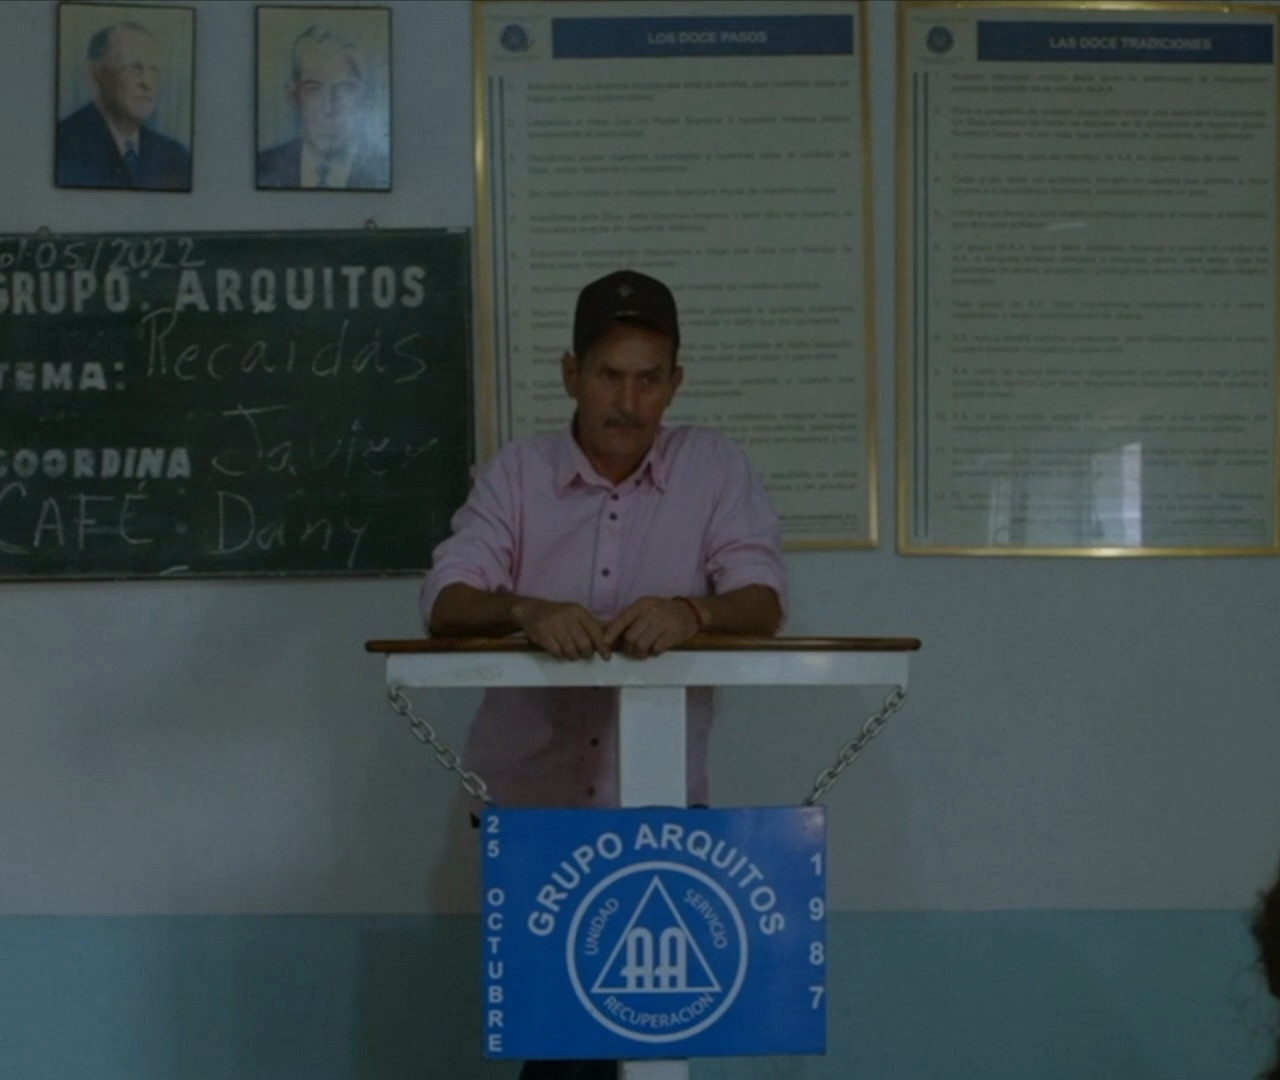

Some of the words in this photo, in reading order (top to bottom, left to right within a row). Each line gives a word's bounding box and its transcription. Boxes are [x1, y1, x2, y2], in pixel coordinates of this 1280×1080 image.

[647, 31, 676, 44] LOS
[679, 31, 717, 44] DOCE
[720, 30, 768, 44] PASOS
[1049, 36, 1077, 50] LAS
[1079, 36, 1118, 50] DOCE
[1120, 36, 1213, 51] TRADICIONES
[175, 265, 427, 315] ARQUITOS
[527, 831, 624, 938] GRUPO
[633, 822, 786, 936] ARQUITOS
[584, 896, 620, 957] UNIDAD
[682, 887, 729, 950] SERVICIO
[807, 851, 826, 1011] 1987
[486, 887, 505, 1053] OCTUBRE
[619, 926, 688, 989] AA
[602, 991, 715, 1029] RECUPERACION
